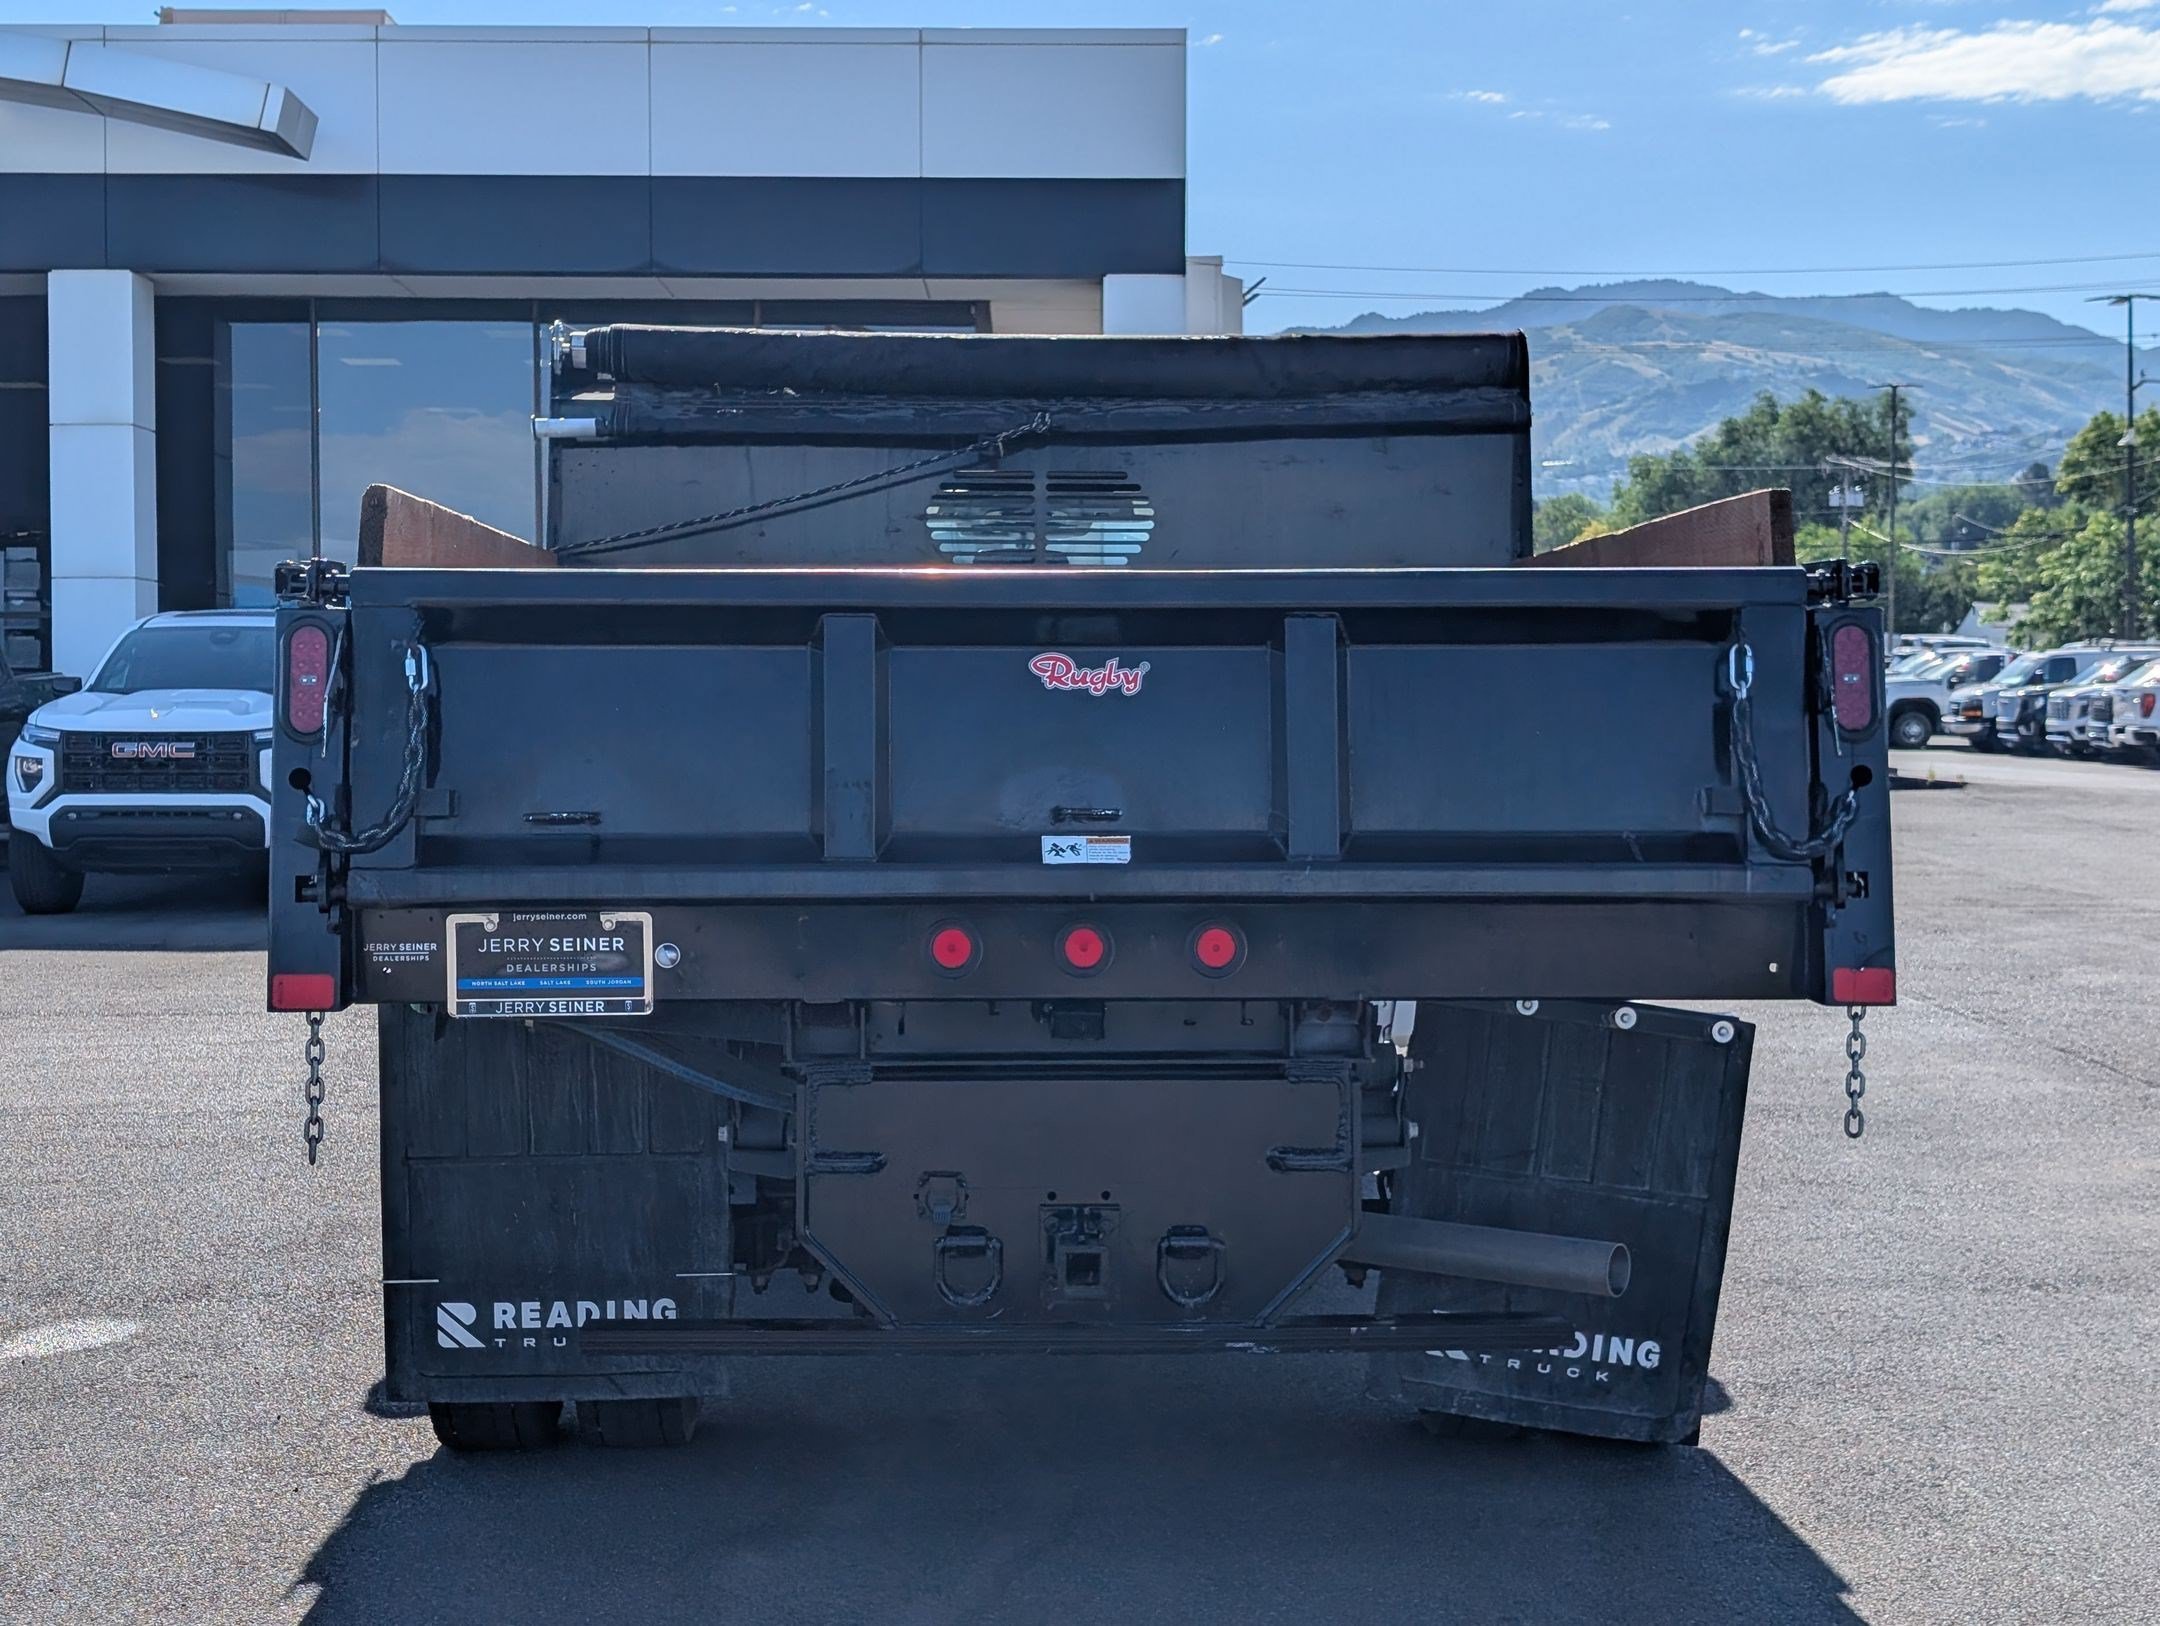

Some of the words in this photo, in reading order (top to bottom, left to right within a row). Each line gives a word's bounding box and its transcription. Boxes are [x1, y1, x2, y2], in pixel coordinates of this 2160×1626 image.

[111, 742, 195, 758] GMC
[513, 912, 587, 922] jerryseiner.com
[363, 943, 397, 952] JERRY
[399, 942, 438, 951] SEINER
[478, 938, 544, 953] JERRY
[549, 937, 625, 952] SEINER
[372, 954, 430, 962] DEALERSHIPS
[506, 963, 598, 973] DEALERSHIPS
[495, 1001, 545, 1014] JERRY
[549, 1001, 605, 1013] SEINER
[493, 1297, 677, 1329] READING
[494, 1336, 567, 1348] TRU
[1531, 1330, 1661, 1369] DING
[1479, 1353, 1609, 1382] TRUCK
